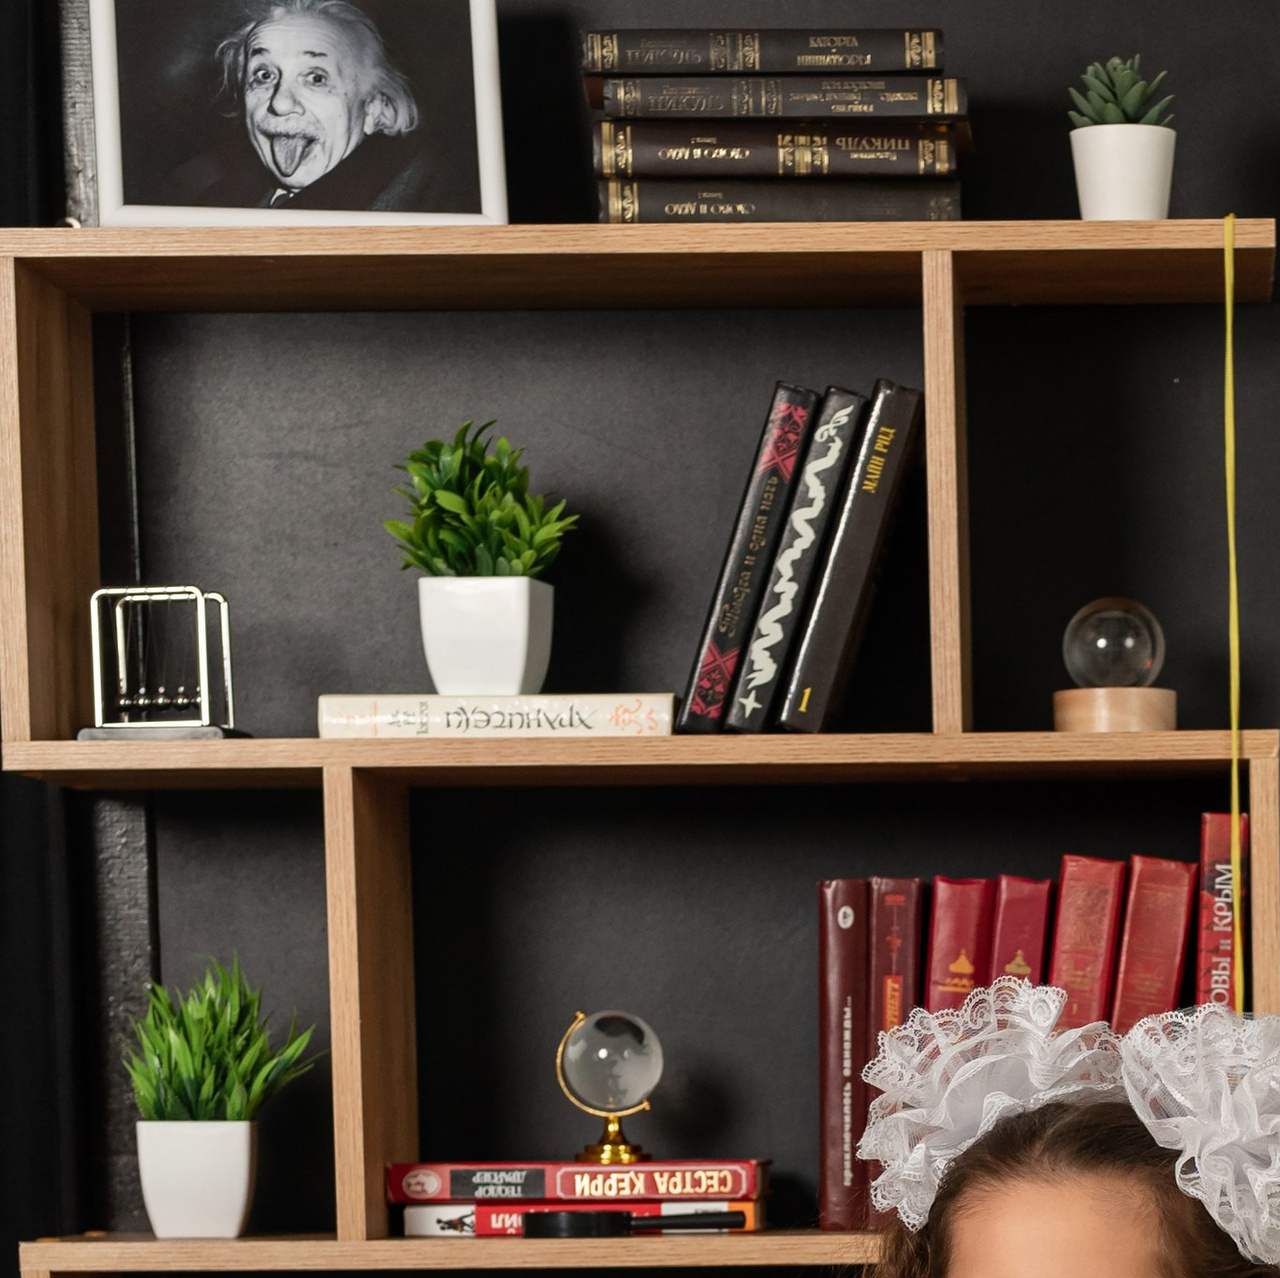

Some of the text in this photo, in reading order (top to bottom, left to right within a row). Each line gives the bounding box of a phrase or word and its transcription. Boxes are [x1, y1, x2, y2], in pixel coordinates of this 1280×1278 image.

[835, 136, 911, 151] ПИКУЛЬ
[862, 426, 896, 494] МАЙН РИД
[798, 687, 812, 713] 1
[1213, 863, 1233, 932] КРЫМ
[842, 1081, 854, 1187] приключилось
[471, 1170, 527, 1185] ДРАЙЗЕР
[474, 1184, 523, 1198] ТЕОДОР
[573, 1170, 733, 1198] СЕСТРА КЕРРИ
